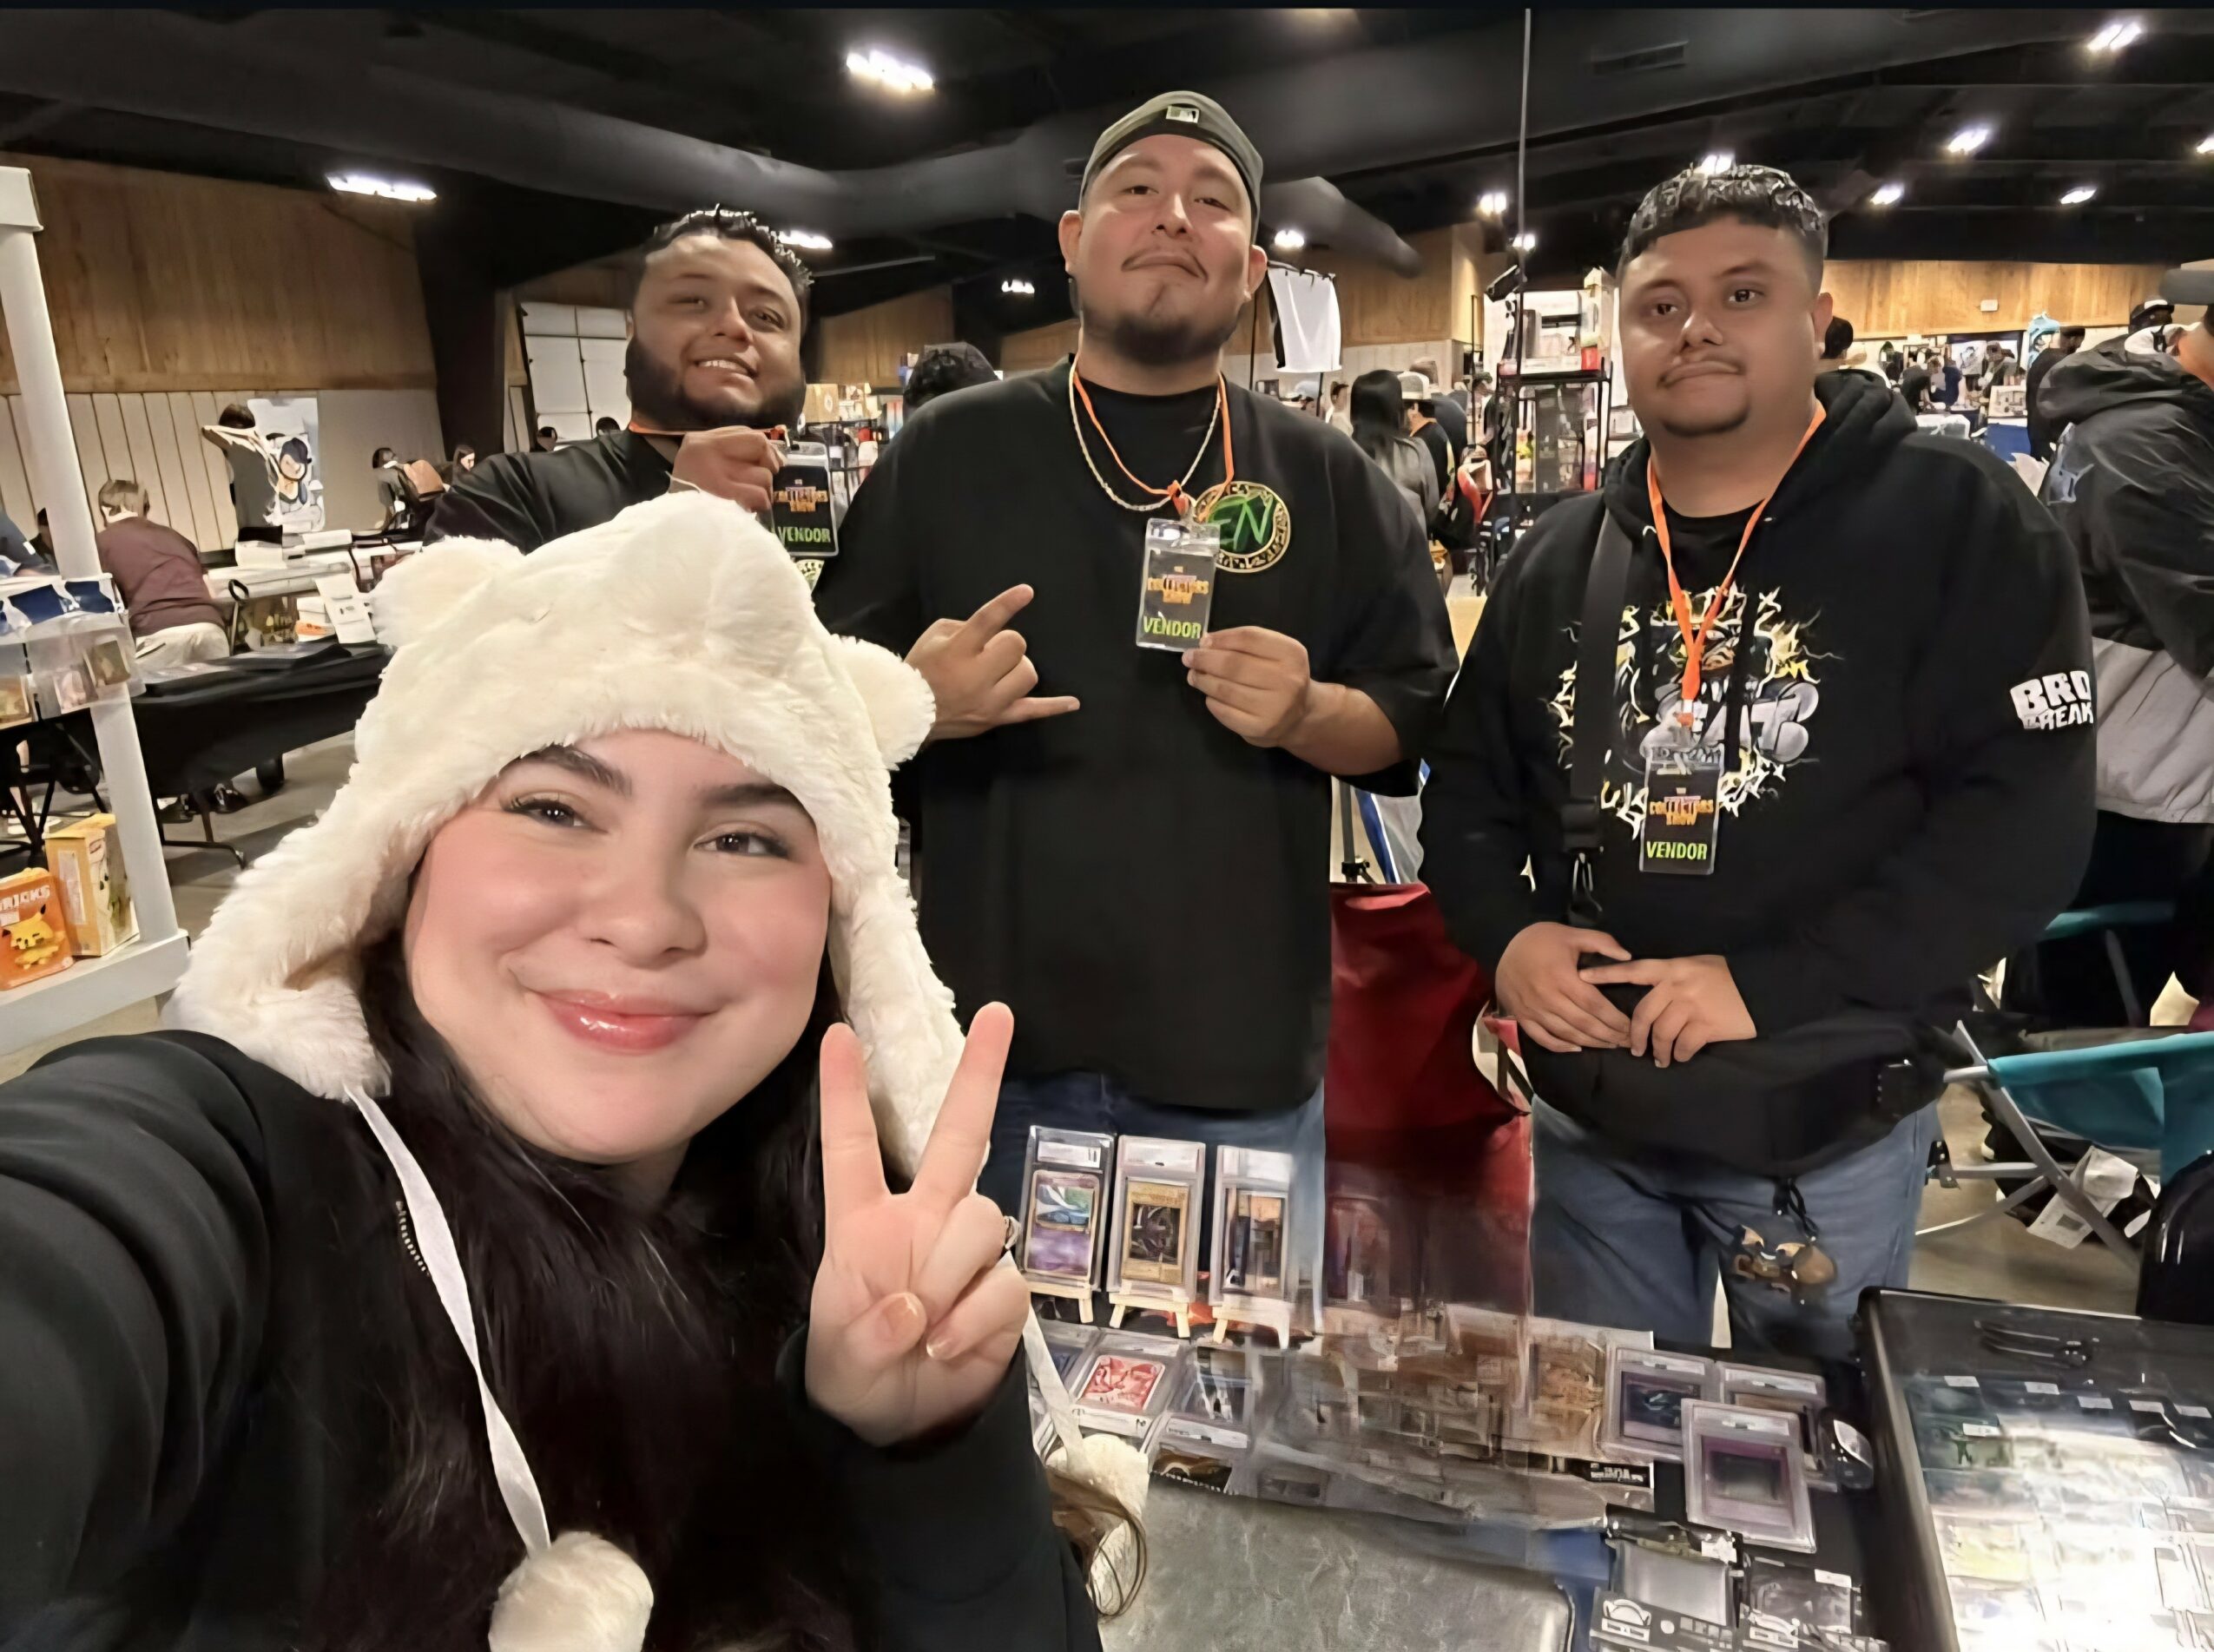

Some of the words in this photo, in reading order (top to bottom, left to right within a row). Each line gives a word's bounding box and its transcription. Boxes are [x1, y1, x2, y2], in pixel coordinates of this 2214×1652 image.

[778, 526, 831, 543] VENDOR
[1143, 615, 1202, 639] VENDOR
[1646, 841, 1708, 860] VENDOR
